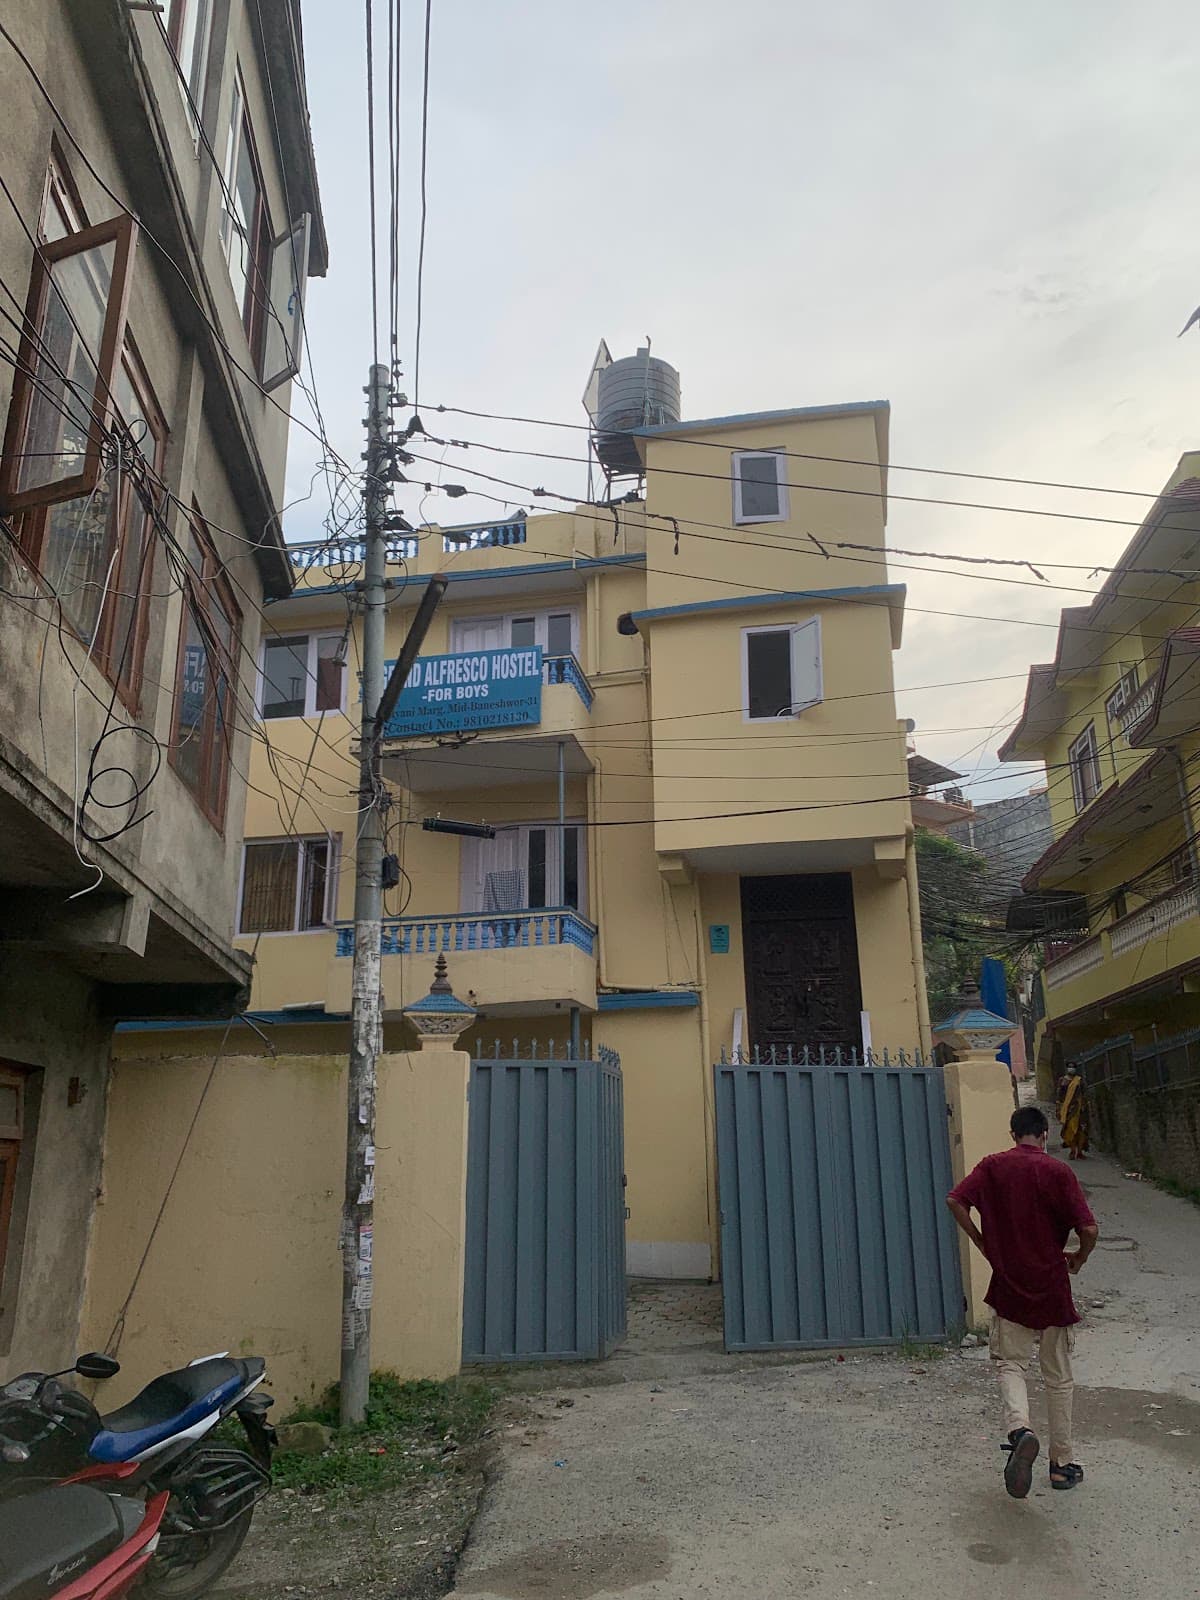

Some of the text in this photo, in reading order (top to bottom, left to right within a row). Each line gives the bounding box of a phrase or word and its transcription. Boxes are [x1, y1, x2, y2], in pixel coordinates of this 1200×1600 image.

[424, 656, 488, 687] ALFRESCO
[491, 651, 539, 680] HOSTEL
[456, 684, 489, 699] BOYS
